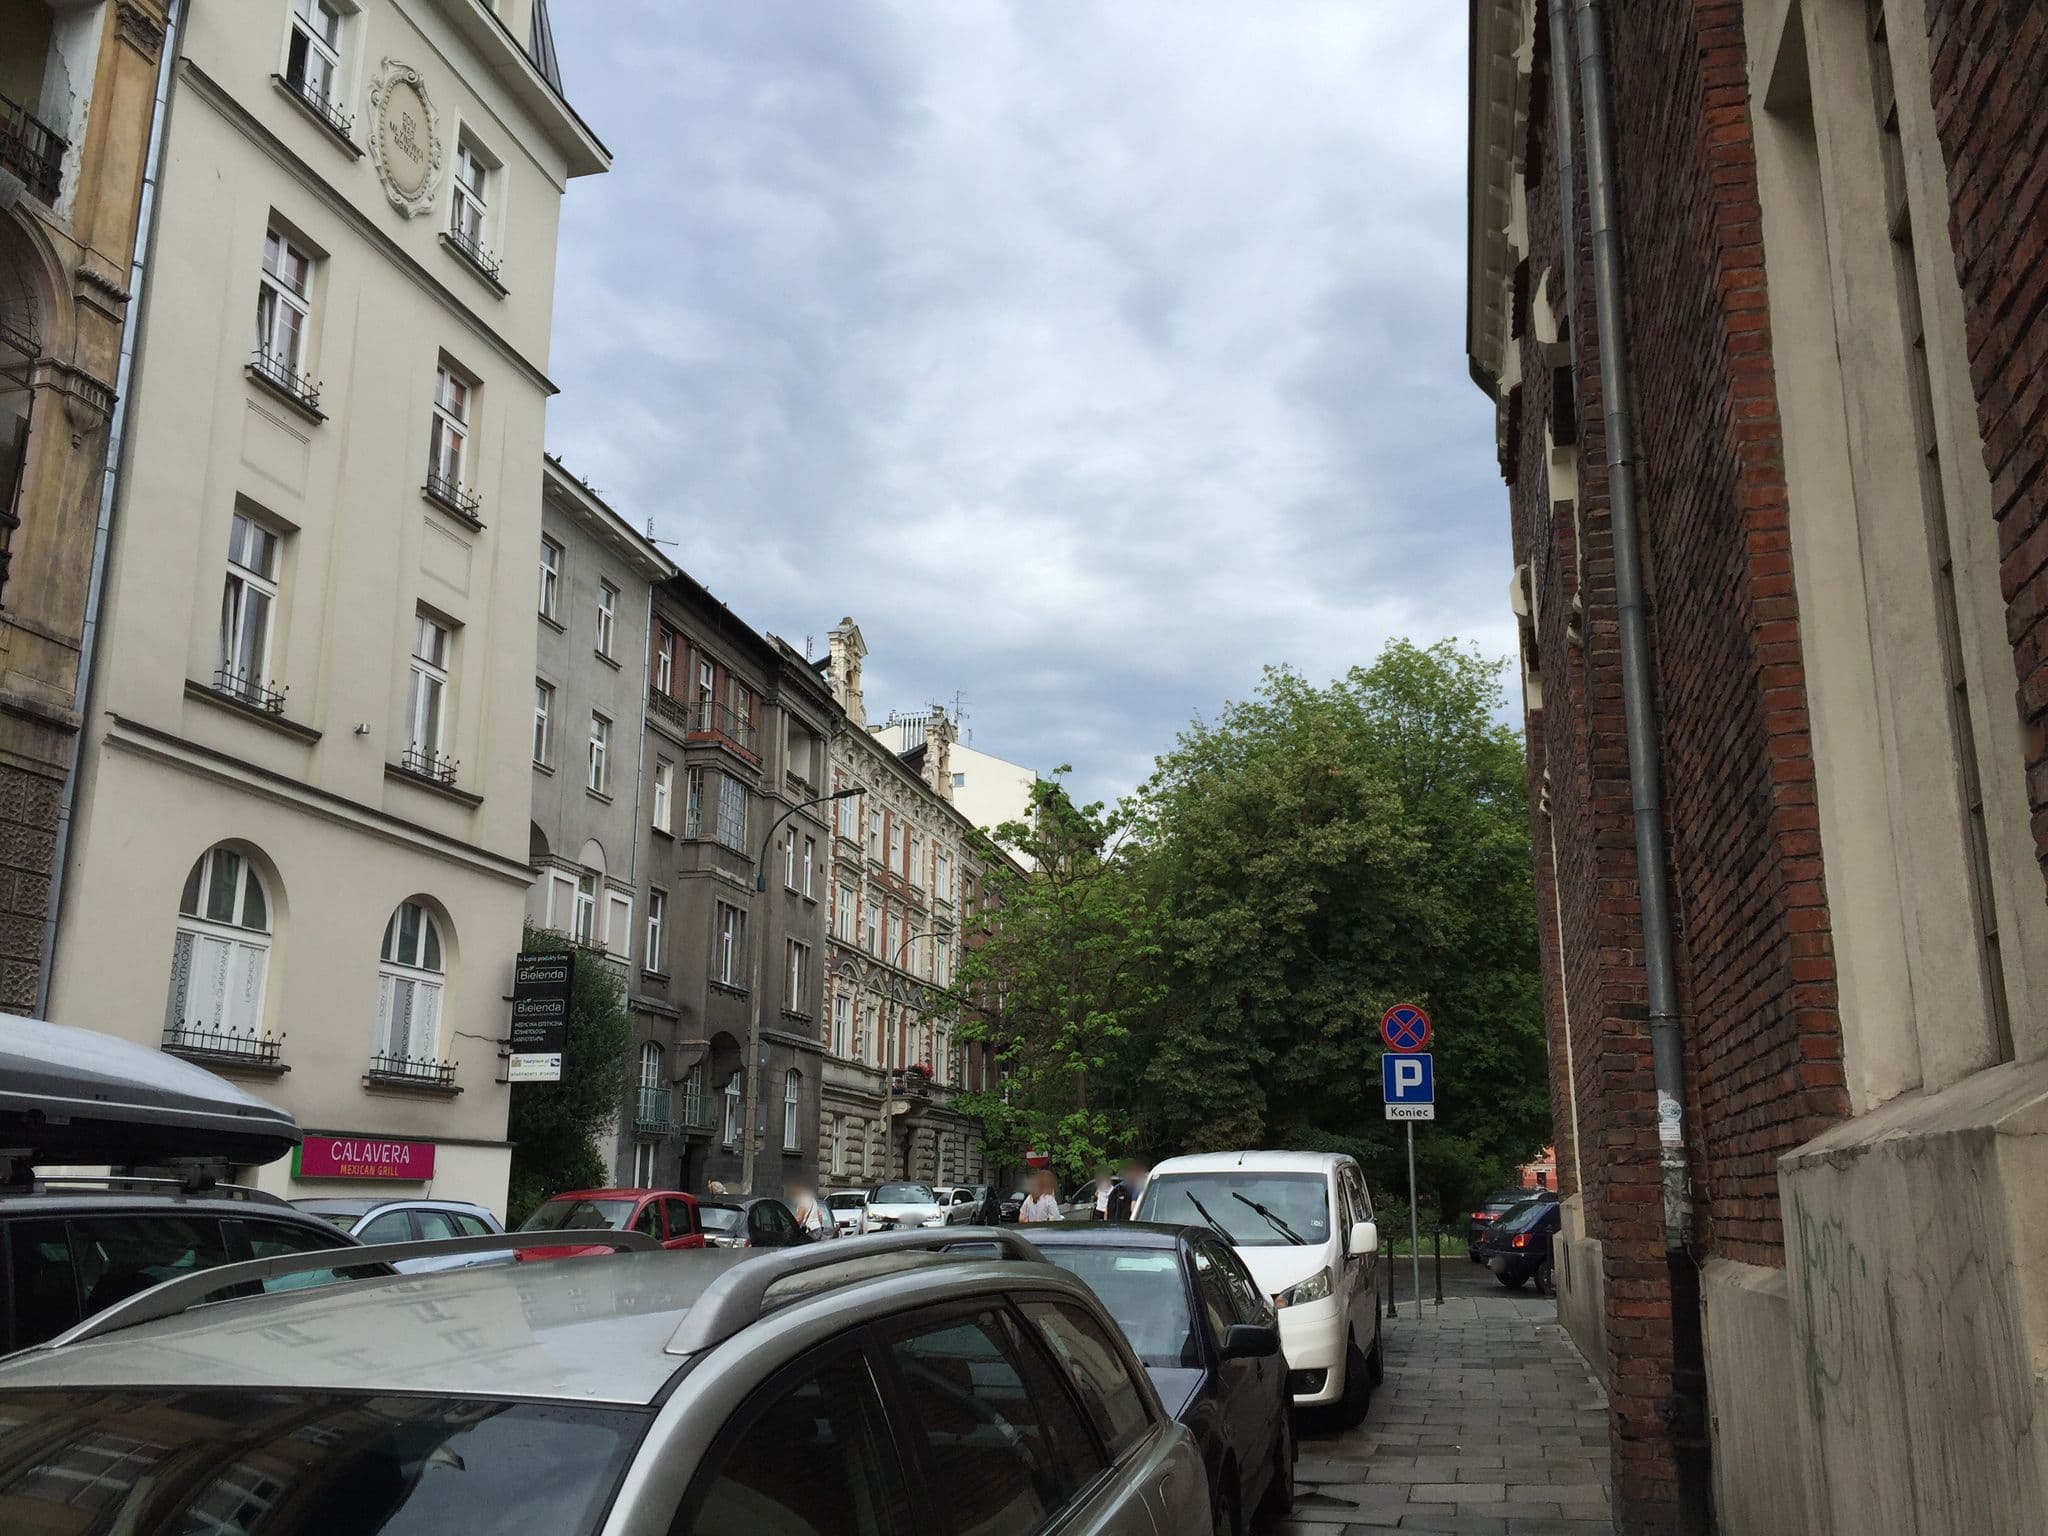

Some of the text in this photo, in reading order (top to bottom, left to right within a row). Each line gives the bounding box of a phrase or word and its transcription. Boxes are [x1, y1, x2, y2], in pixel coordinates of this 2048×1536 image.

[520, 969, 564, 980] Bielenda
[517, 1002, 562, 1013] Bielenda
[1394, 1059, 1423, 1097] P
[1391, 1107, 1429, 1117] Koniec
[331, 1141, 410, 1164] CALAVERA
[340, 1164, 399, 1176] MEXICAN GRILL
